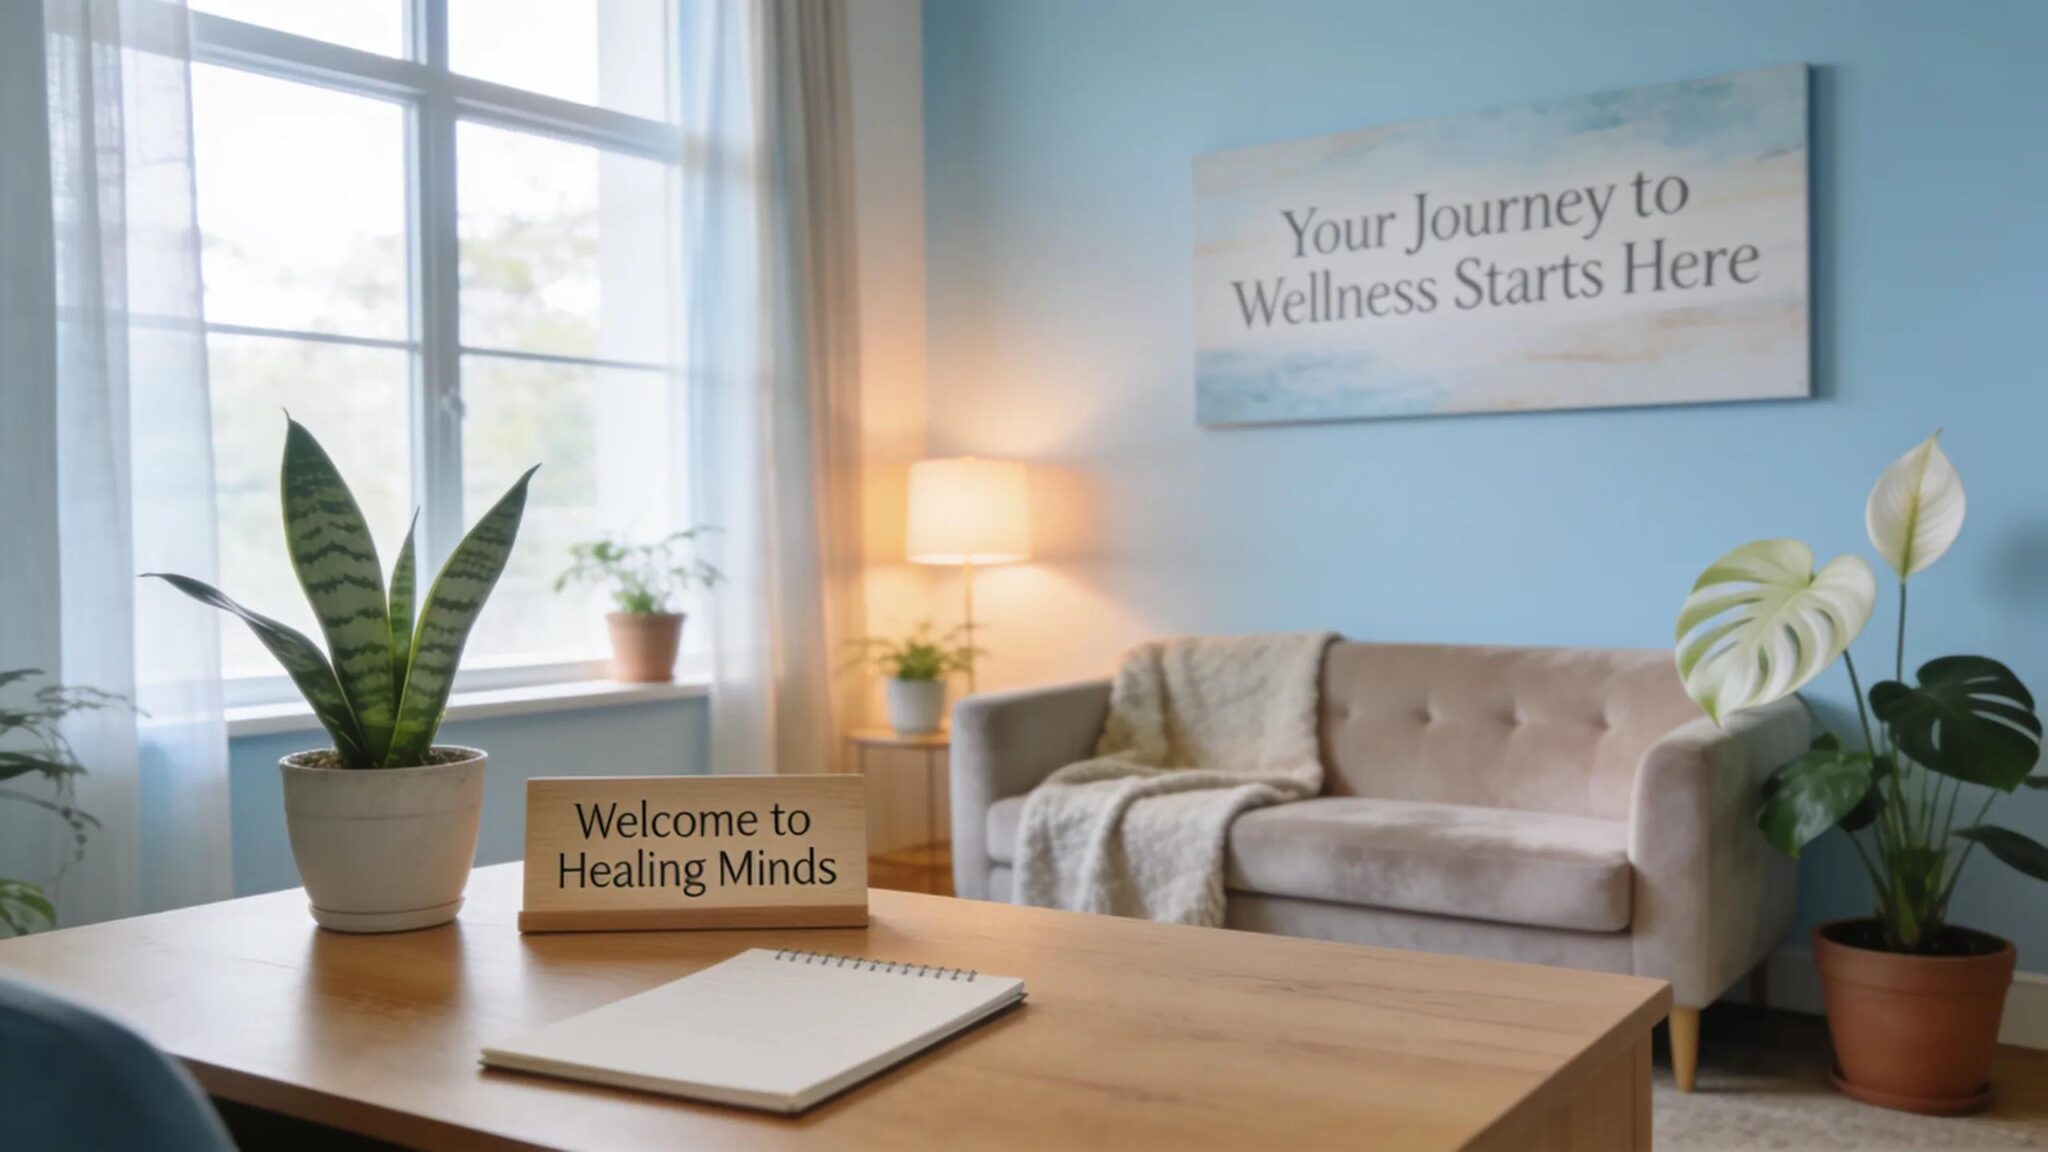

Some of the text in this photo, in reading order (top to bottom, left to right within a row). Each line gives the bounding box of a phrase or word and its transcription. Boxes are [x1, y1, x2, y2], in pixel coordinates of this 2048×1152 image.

[1281, 171, 1690, 258] Your Journey to
[1232, 238, 1761, 329] Wellness Starts Here
[575, 799, 811, 840] Welcome to
[559, 846, 837, 898] Healing Minds
